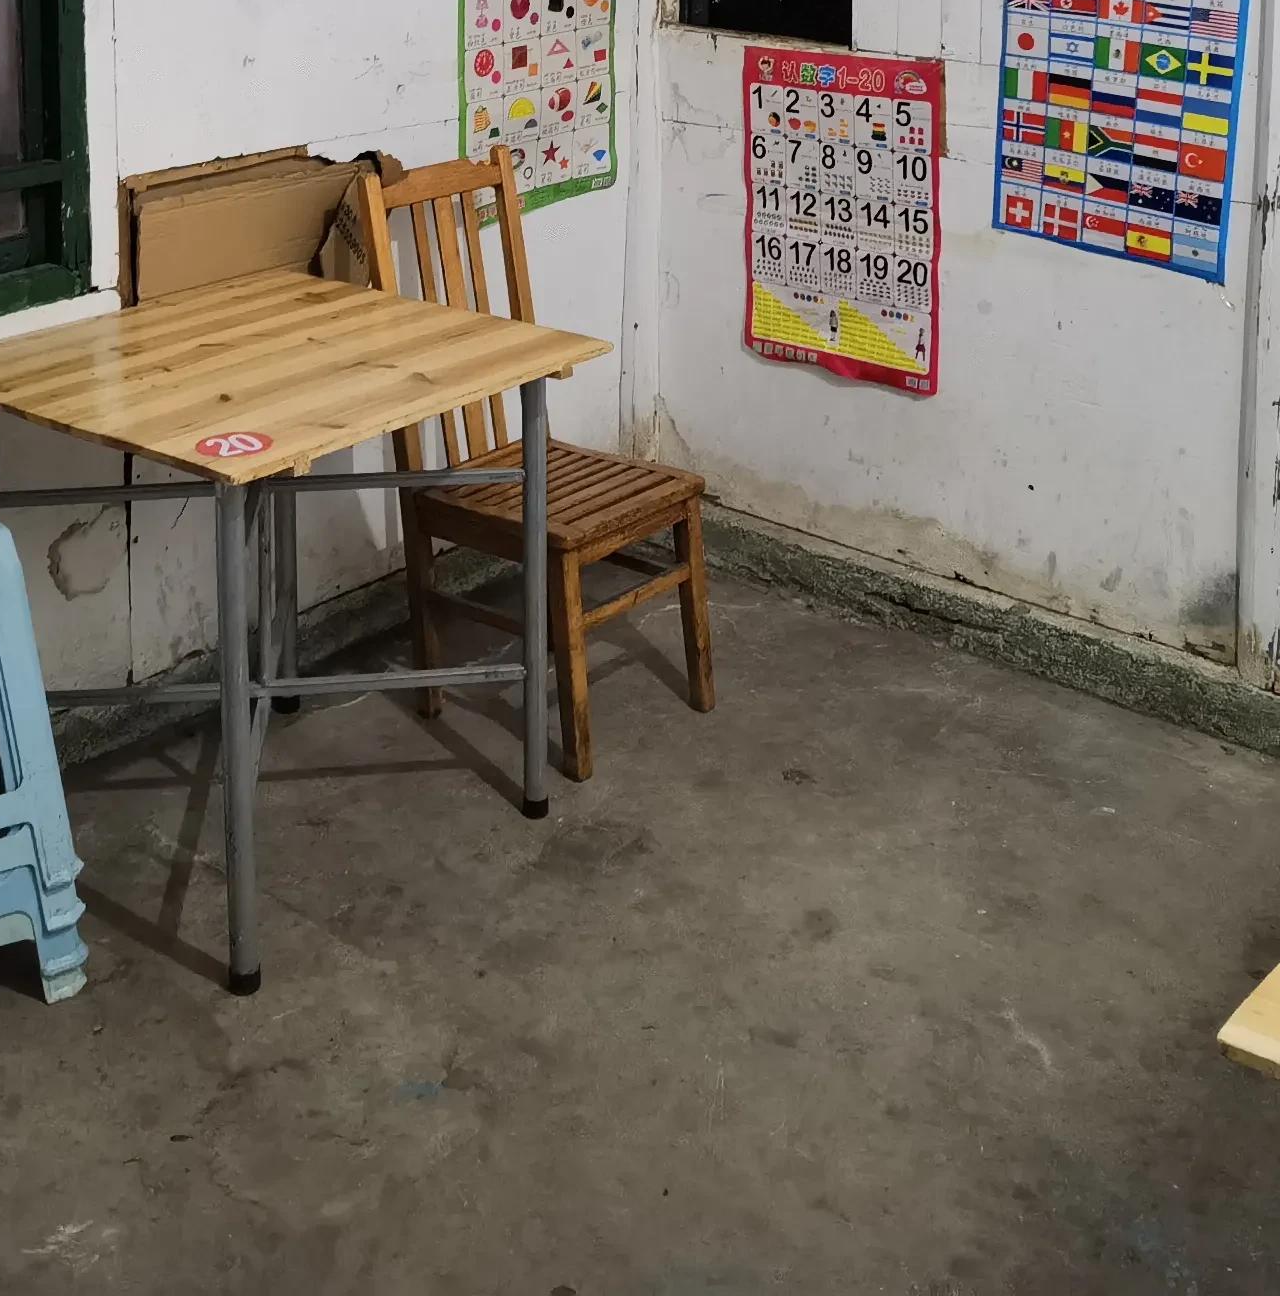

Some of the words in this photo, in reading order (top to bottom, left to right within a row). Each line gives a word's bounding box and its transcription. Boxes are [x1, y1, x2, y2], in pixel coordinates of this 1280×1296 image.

[752, 85, 763, 109] 1
[785, 88, 800, 114] 2
[820, 93, 835, 118] 3
[855, 97, 873, 123] 4
[895, 101, 912, 127] 5
[752, 135, 767, 159] 6
[788, 139, 802, 164] 7
[821, 144, 836, 170] 8
[856, 149, 873, 175] 9
[896, 154, 927, 182] 10
[756, 185, 780, 211] 11
[789, 190, 817, 218] 12
[824, 196, 853, 223] 13
[860, 201, 891, 229] 14
[897, 207, 929, 235] 15
[755, 234, 782, 261] 16
[789, 240, 817, 267] 17
[823, 246, 852, 274] 18
[859, 253, 889, 280] 19
[896, 259, 928, 288] 20
[205, 433, 263, 457] 20
